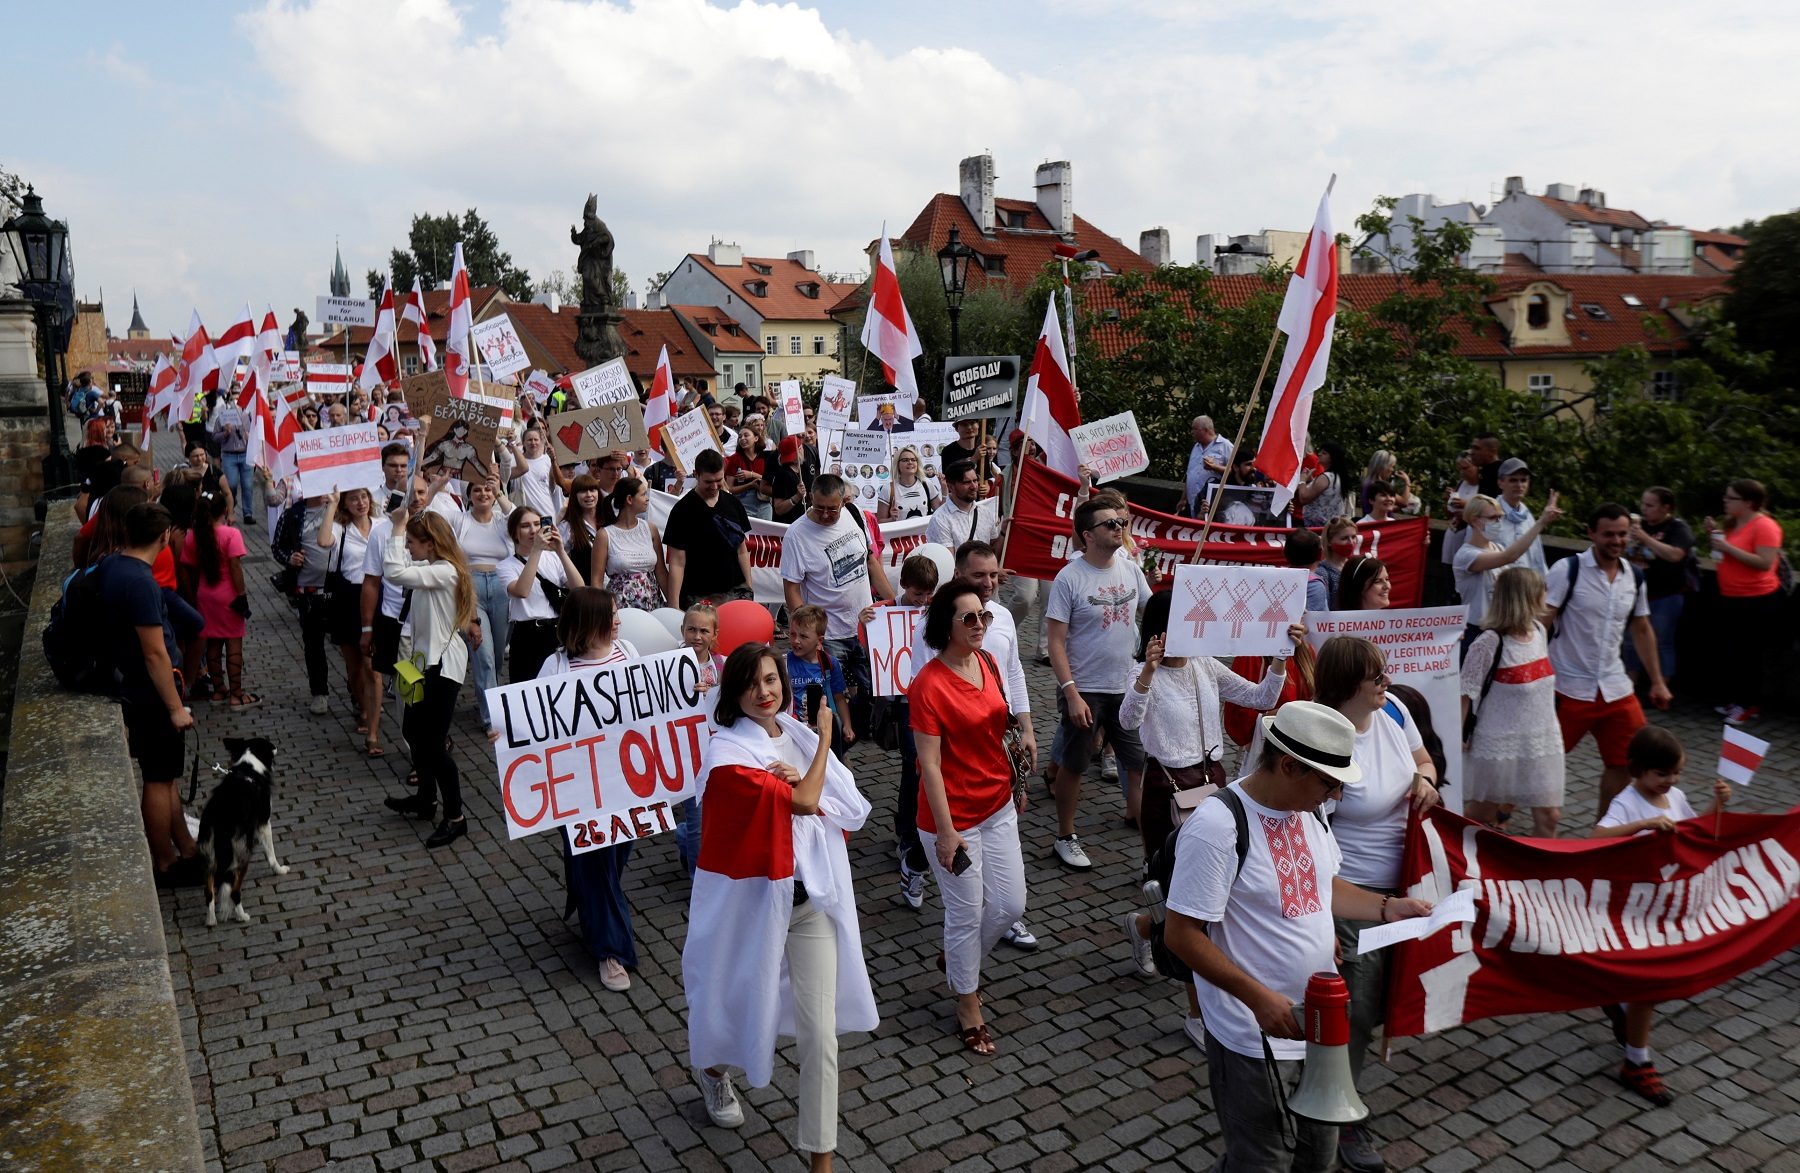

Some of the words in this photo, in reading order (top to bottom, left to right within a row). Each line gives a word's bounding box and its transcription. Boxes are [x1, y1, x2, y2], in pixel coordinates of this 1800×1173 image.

[327, 299, 366, 308] FREEDOM
[340, 307, 351, 315] for
[328, 315, 365, 323] BELARUS
[952, 360, 1001, 387] СВОБОДУ
[947, 387, 1013, 419] ЗАКЛЮЧЕННЫМ!
[949, 383, 982, 403] ПОЛИТ-
[434, 404, 498, 429] БЕЛАРУСЬ
[447, 397, 486, 415] ЖЫВЕ
[299, 437, 324, 453] ЖЫВЕ
[329, 431, 376, 448] БЕЛАРУСЬ
[1075, 431, 1089, 443] НА
[1089, 425, 1105, 439] ЯГО
[1105, 420, 1132, 436] РУКАХ
[1316, 622, 1335, 633] WE
[1338, 620, 1385, 632] DEMAND
[1388, 619, 1403, 629] TO
[1405, 615, 1463, 628] RECOGNIZE
[1387, 663, 1400, 674] OF
[500, 654, 700, 749] LUKASHENKO
[502, 734, 606, 828] GET
[619, 714, 707, 799] OUT
[573, 819, 605, 849] 26
[611, 801, 669, 844] ЛЕТ
